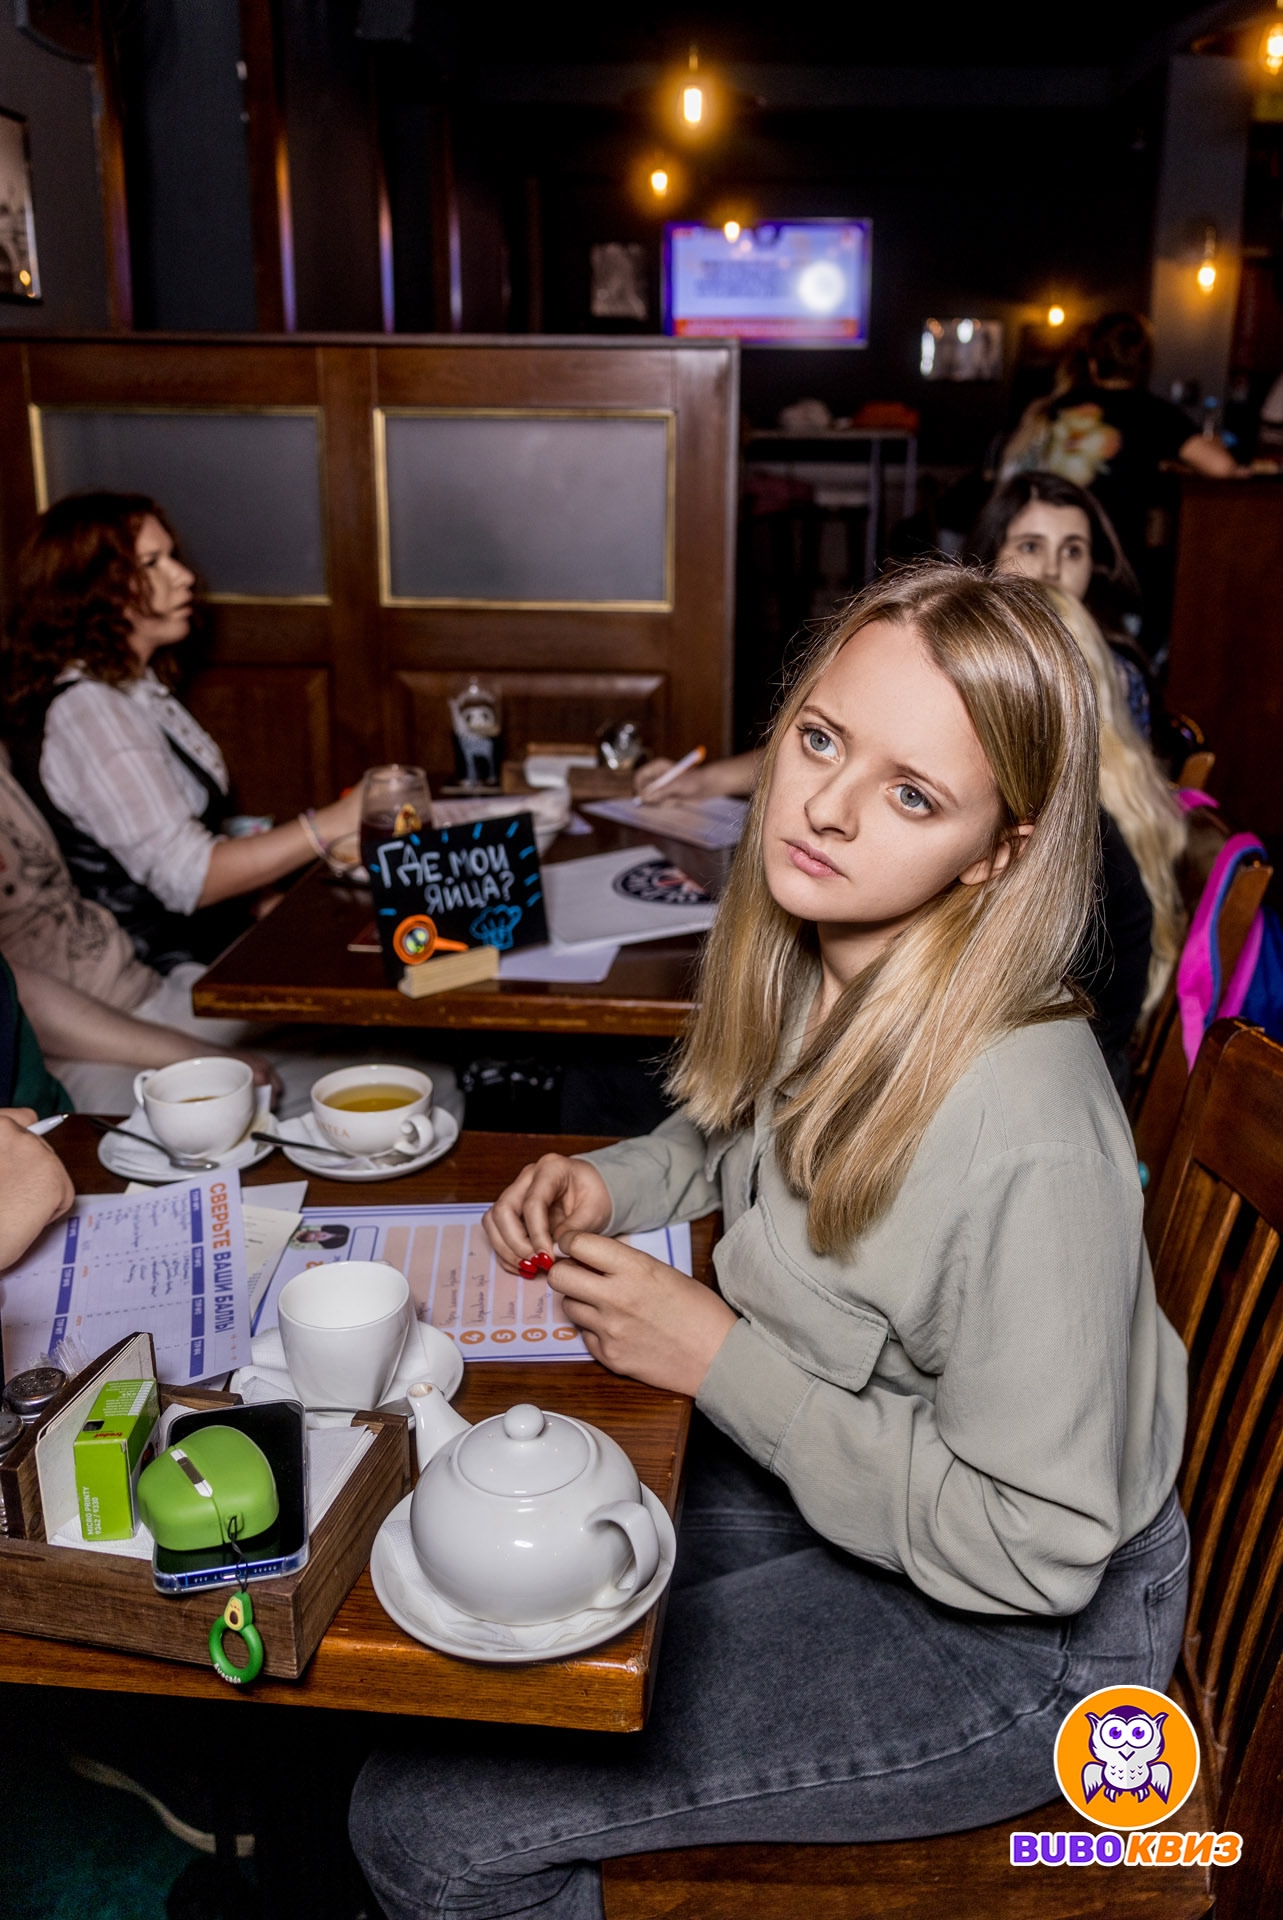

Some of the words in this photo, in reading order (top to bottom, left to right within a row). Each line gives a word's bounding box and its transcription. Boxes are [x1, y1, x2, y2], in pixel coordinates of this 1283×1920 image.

[377, 841, 442, 888] ГДЕ
[209, 1182, 231, 1249] СВЕРЬТЕ
[213, 1251, 232, 1293] ВАШИ
[214, 1294, 234, 1333] БАЛЛЫ
[465, 1333, 480, 1342] 4
[527, 1331, 542, 1339] 6
[82, 1486, 91, 1511] PRINTY
[85, 1511, 94, 1536] MICRO
